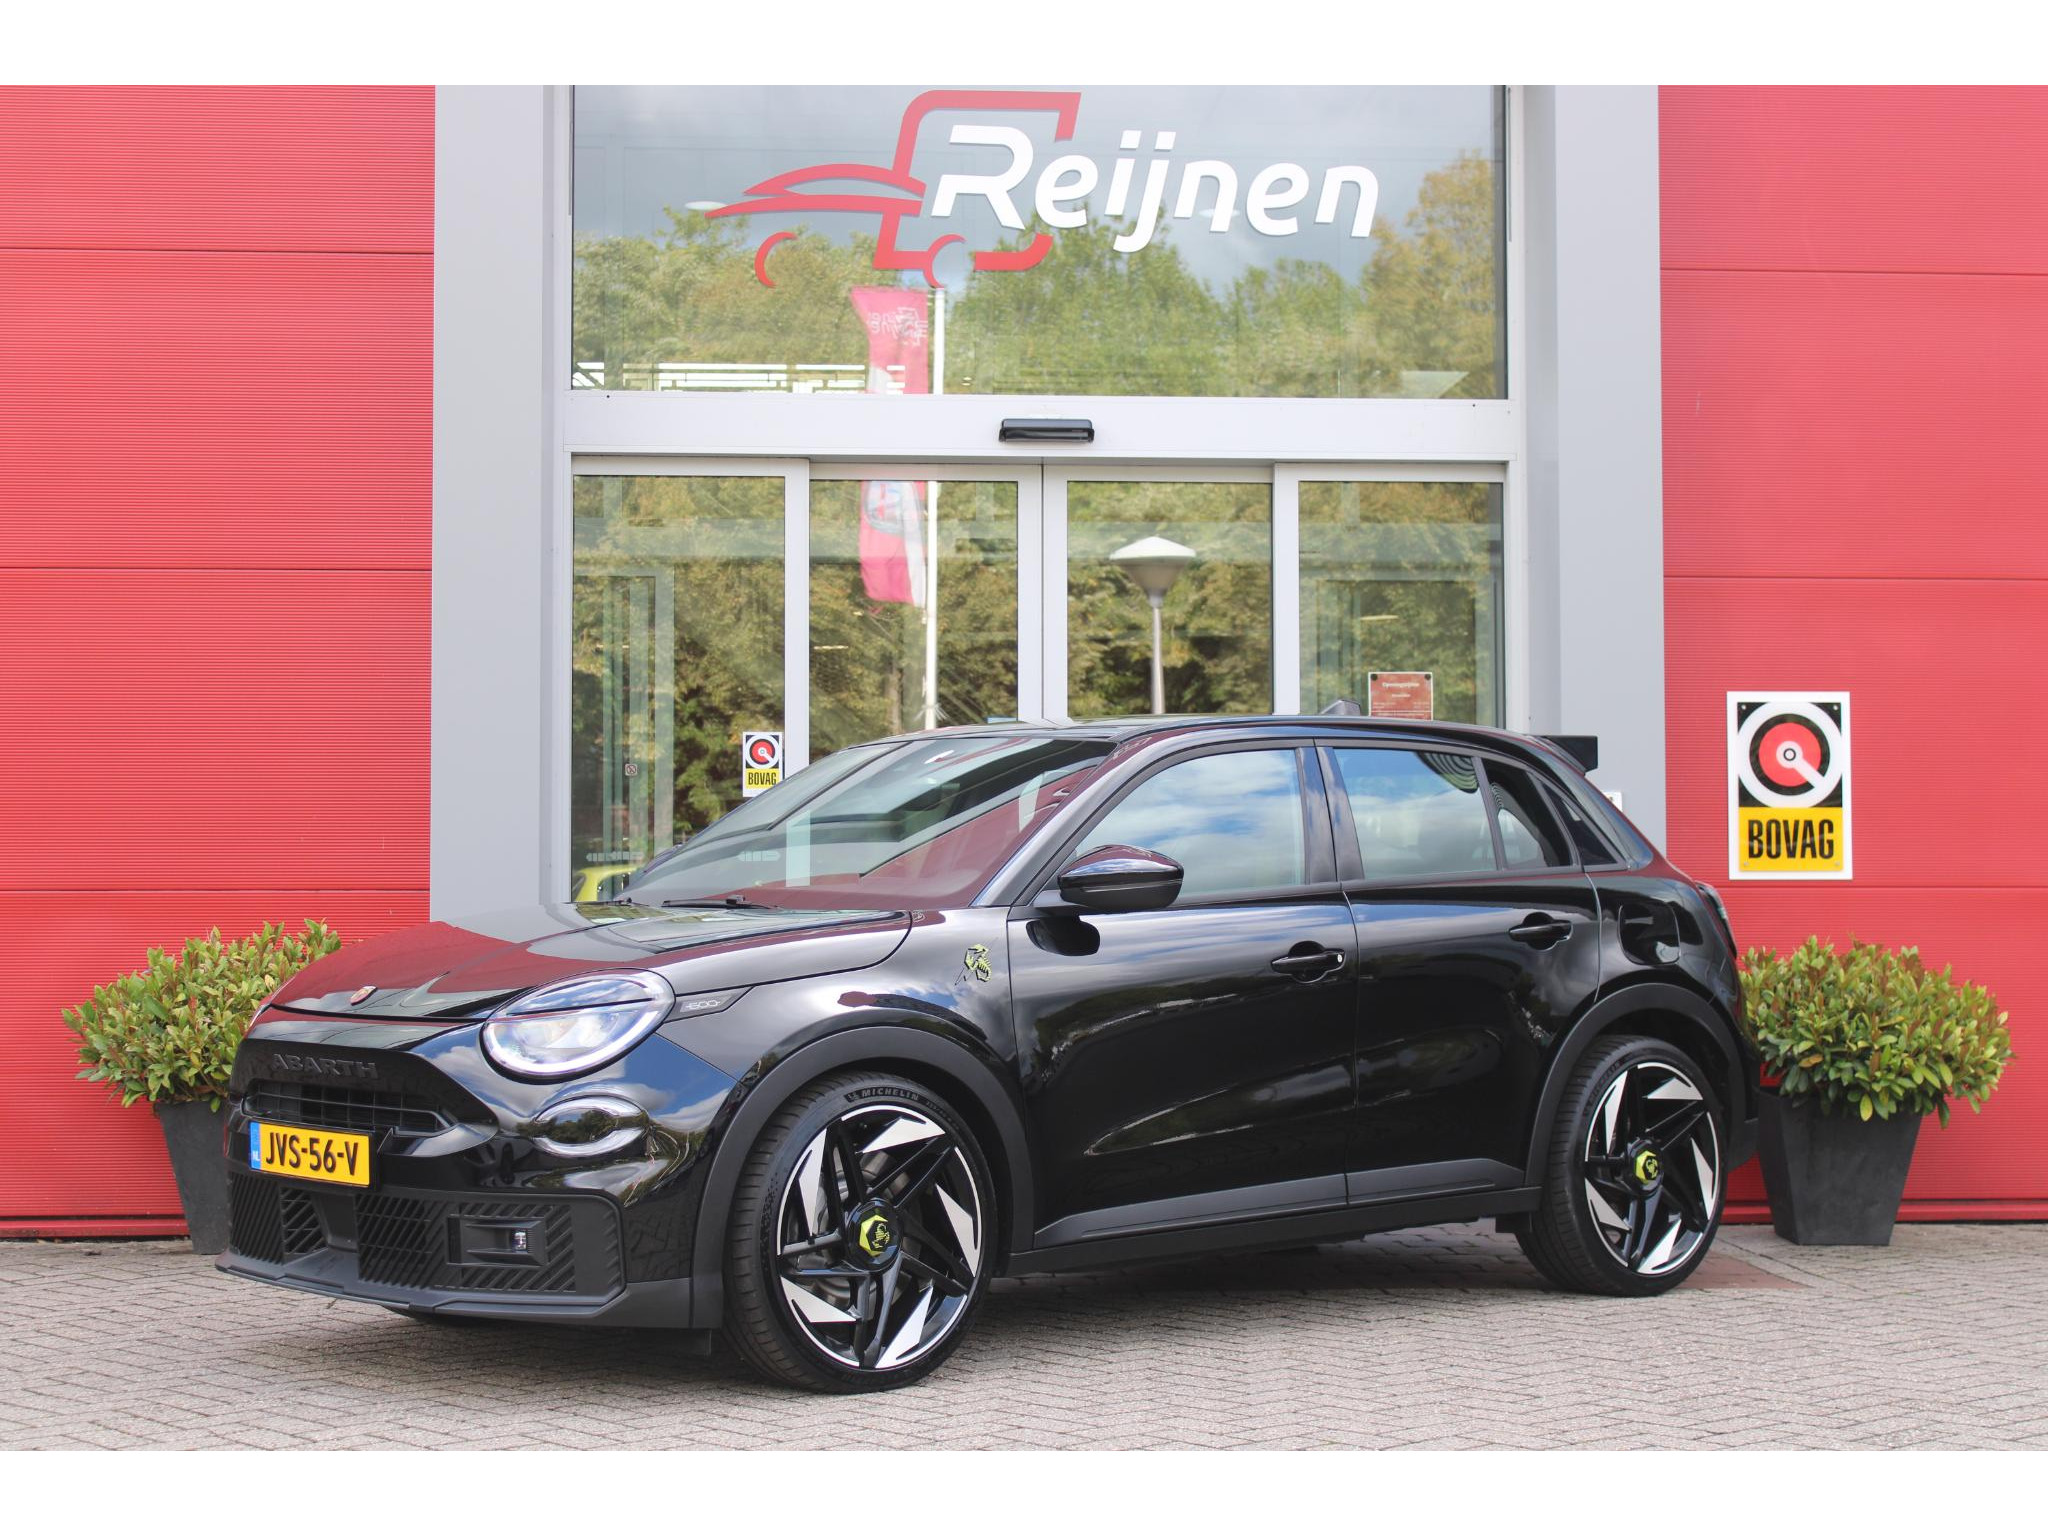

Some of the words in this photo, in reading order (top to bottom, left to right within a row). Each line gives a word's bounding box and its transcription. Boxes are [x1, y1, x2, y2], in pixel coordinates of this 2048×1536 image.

[930, 125, 1380, 253] Reijnen
[748, 772, 777, 786] BOVAG
[1748, 818, 1834, 860] BOVAG
[271, 1053, 378, 1079] ABARTH
[861, 1086, 919, 1101] MICHELIN
[265, 1131, 359, 1176] JVS-56-V
